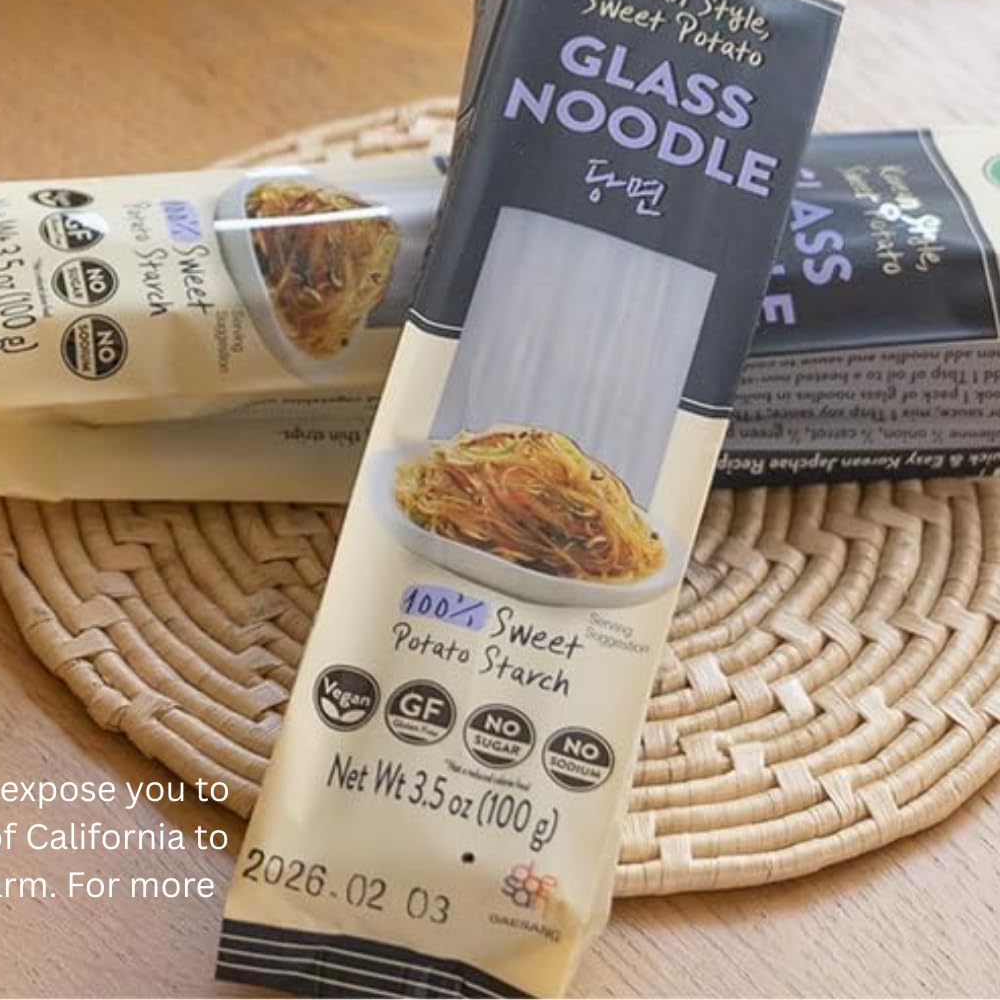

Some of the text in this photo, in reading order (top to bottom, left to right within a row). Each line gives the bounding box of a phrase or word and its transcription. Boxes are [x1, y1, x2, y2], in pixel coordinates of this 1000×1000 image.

[675, 12, 762, 67] Potato
[561, 36, 753, 128] GLASS
[504, 78, 778, 197] NOODLE
[87, 268, 107, 293] NO
[136, 248, 174, 318] Starch
[172, 244, 214, 315] Sweet
[78, 323, 93, 372] SODIUM
[98, 330, 116, 363] NO
[718, 453, 764, 475] Recip
[770, 452, 838, 473] Japchae
[841, 457, 900, 469] Korean
[904, 450, 944, 469] Easy
[402, 588, 584, 660] 100% Sweet
[392, 621, 571, 697] Potato Starch
[323, 676, 371, 708] Vegan
[400, 692, 445, 721] GF
[484, 713, 521, 736] NO
[474, 734, 520, 757] SUGAR
[563, 737, 599, 760] NO
[551, 756, 601, 777] SODIUM
[327, 752, 368, 792] Net
[374, 759, 406, 800] Wt
[408, 769, 448, 810] 3.5
[449, 794, 473, 820] oz
[477, 790, 532, 833] (100
[529, 807, 559, 852] g)
